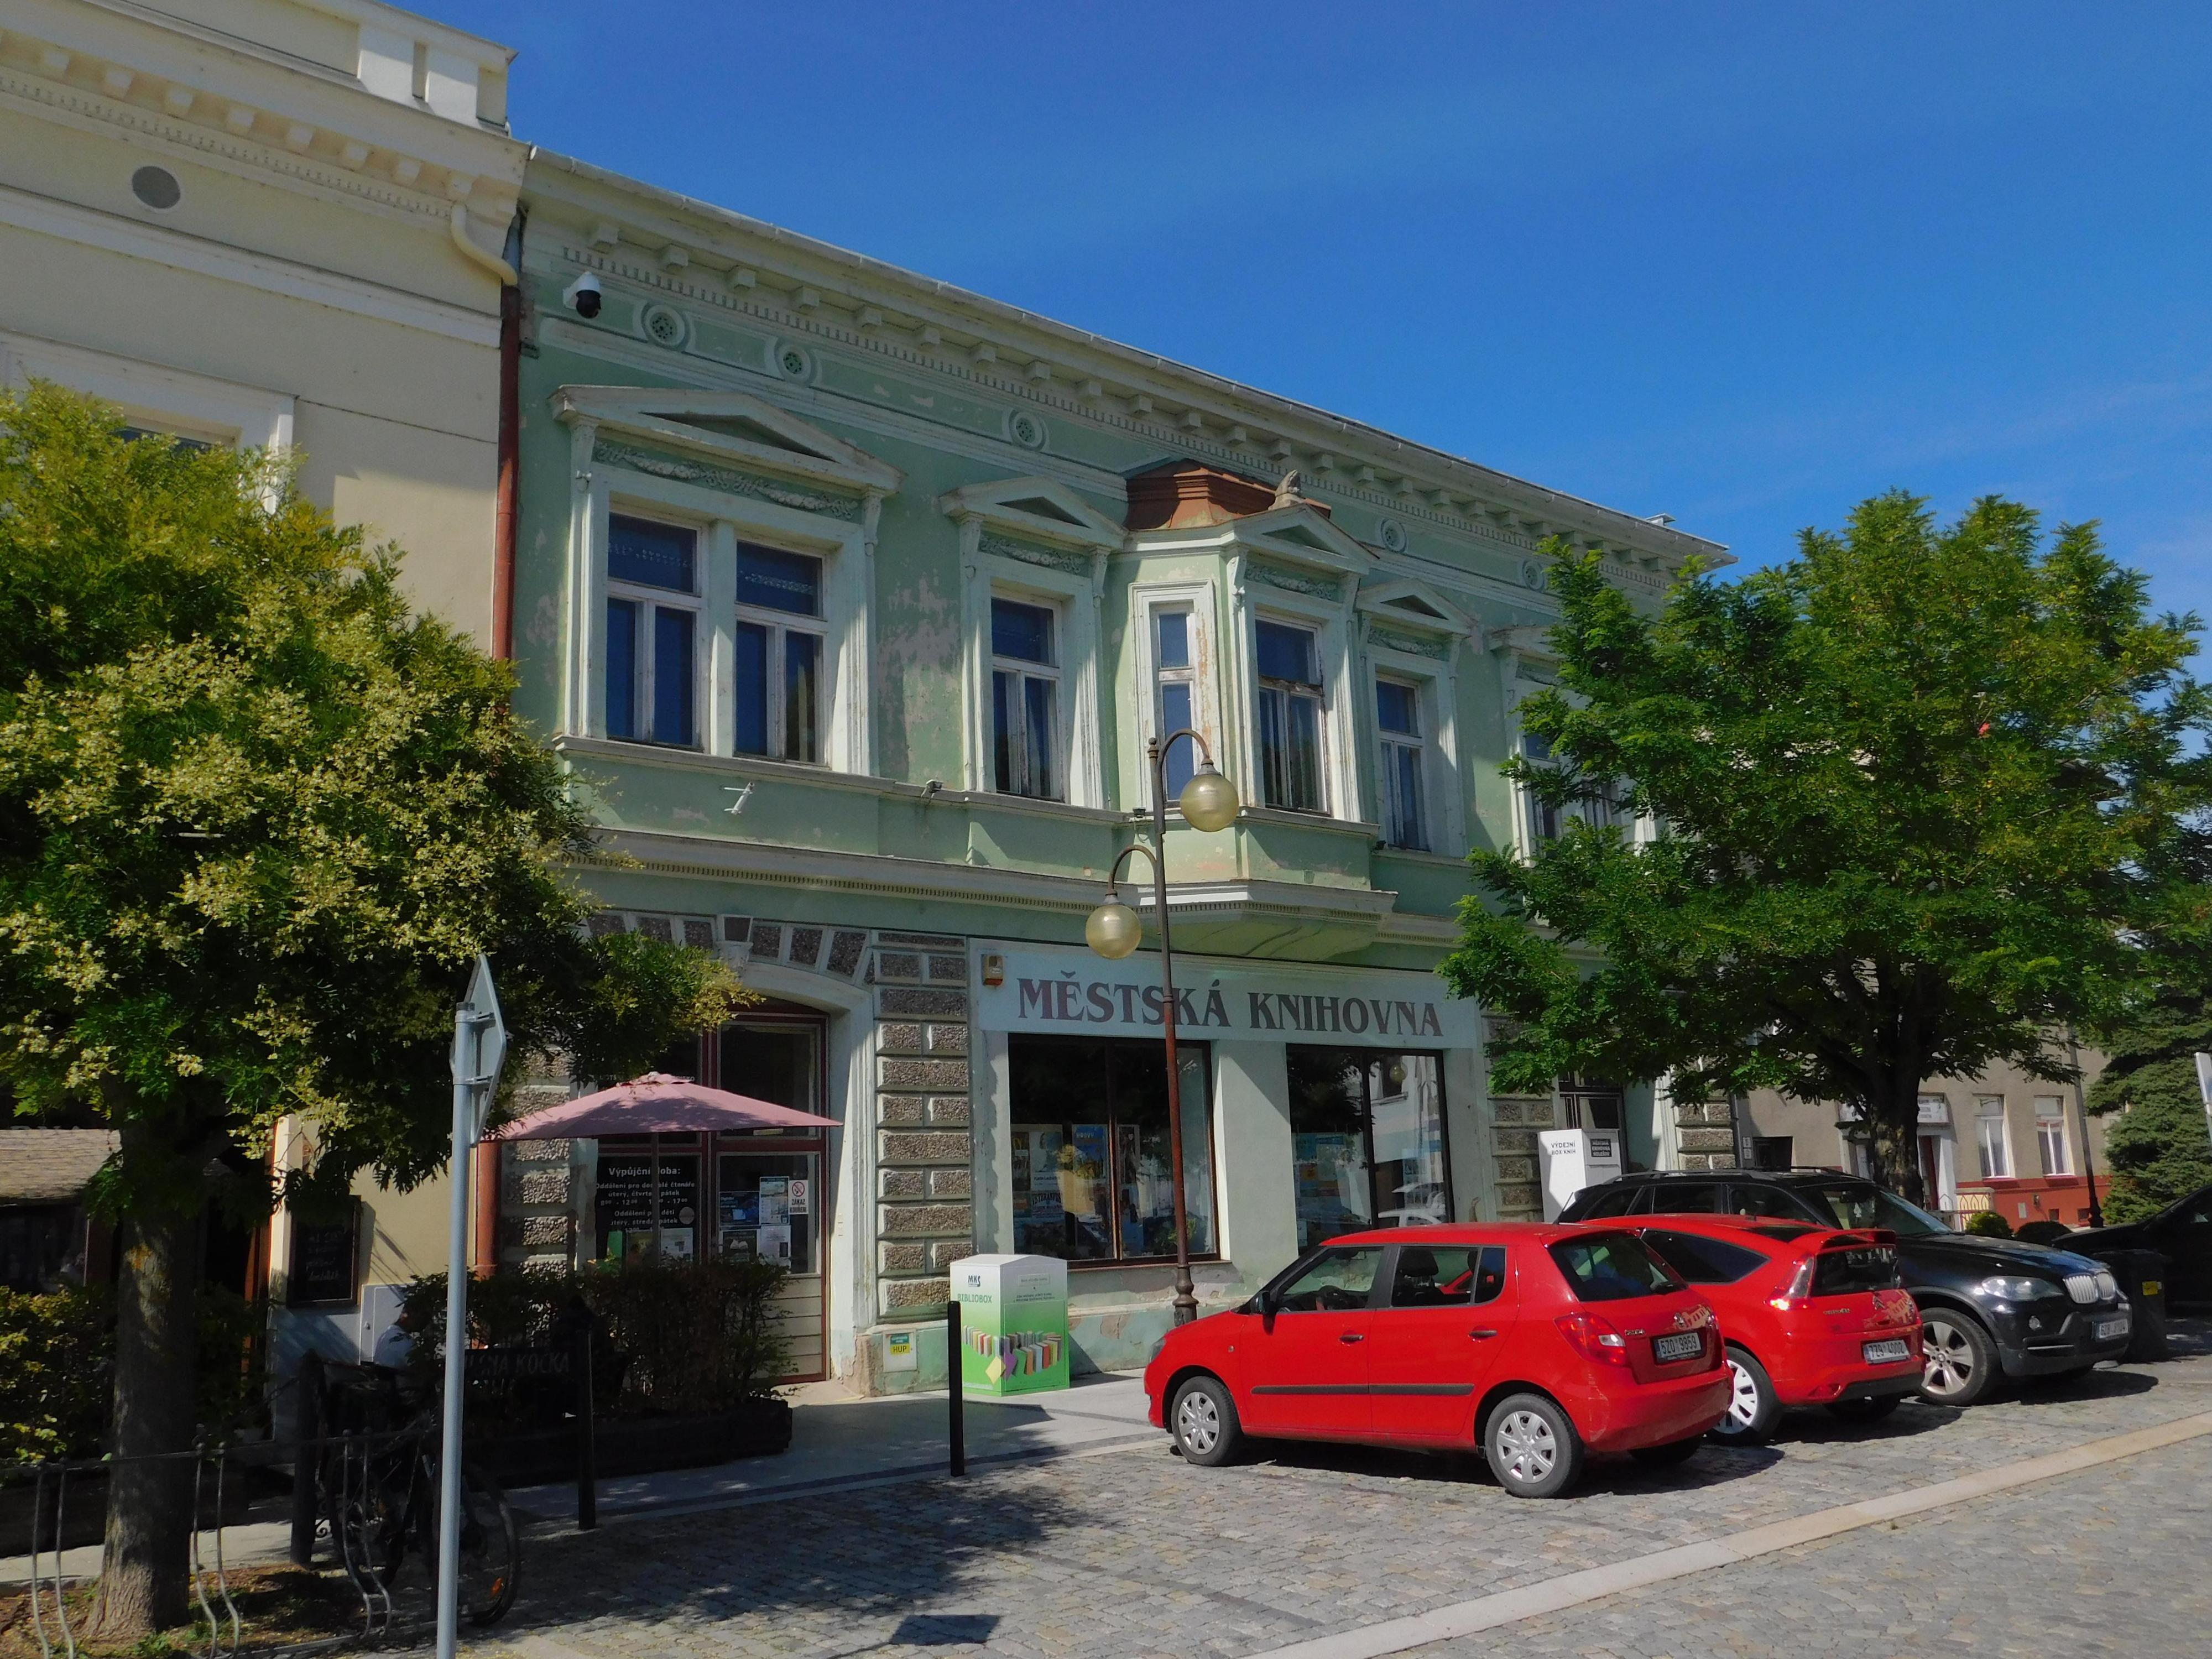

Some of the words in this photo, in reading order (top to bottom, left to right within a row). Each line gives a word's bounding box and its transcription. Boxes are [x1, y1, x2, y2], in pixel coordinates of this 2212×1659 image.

[1017, 970, 1231, 1027] MĚSTSKÁ
[1248, 992, 1445, 1037] KNIHOVNA
[608, 1166, 651, 1177] Výpůjční
[658, 1167, 681, 1175] oba:
[957, 1293, 992, 1304] BIBLIOBOX
